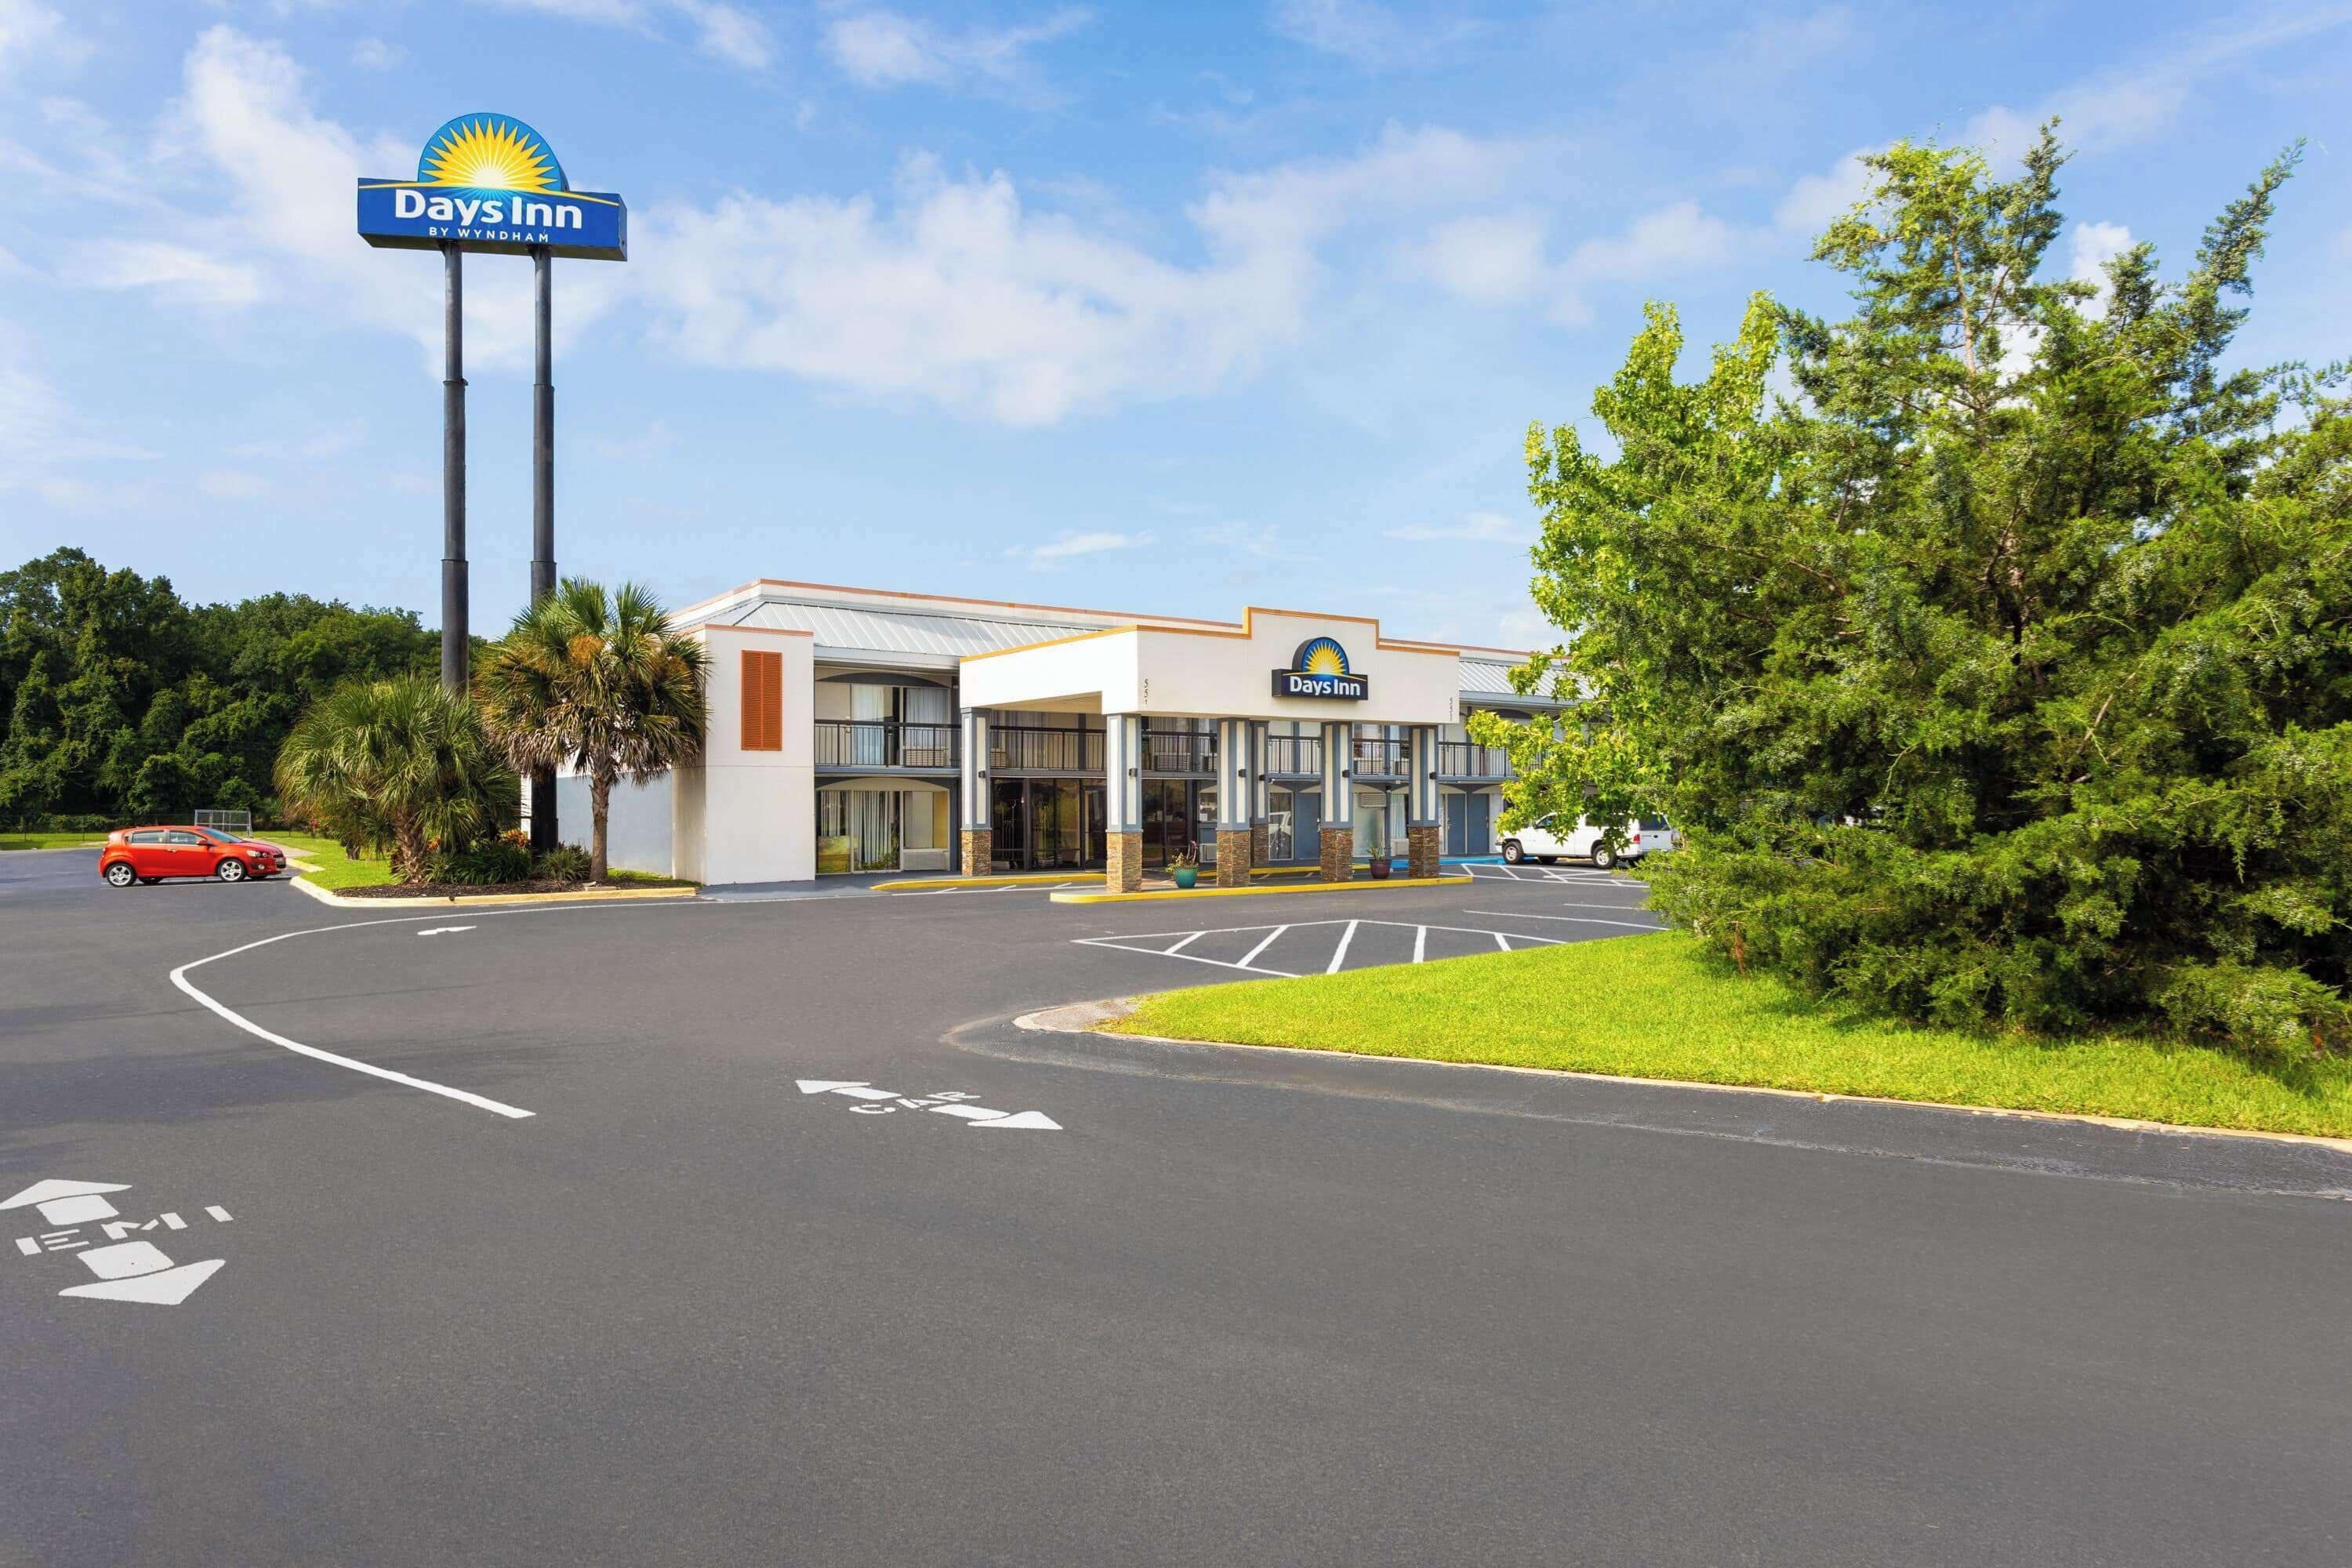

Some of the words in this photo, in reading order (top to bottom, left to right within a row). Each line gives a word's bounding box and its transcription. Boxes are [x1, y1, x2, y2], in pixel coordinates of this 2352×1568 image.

[395, 189, 503, 226] Days
[512, 196, 582, 229] Inn
[429, 227, 449, 237] BY
[458, 228, 549, 242] WYNDHAM
[1290, 676, 1331, 695] Days
[1334, 679, 1360, 695] Inn
